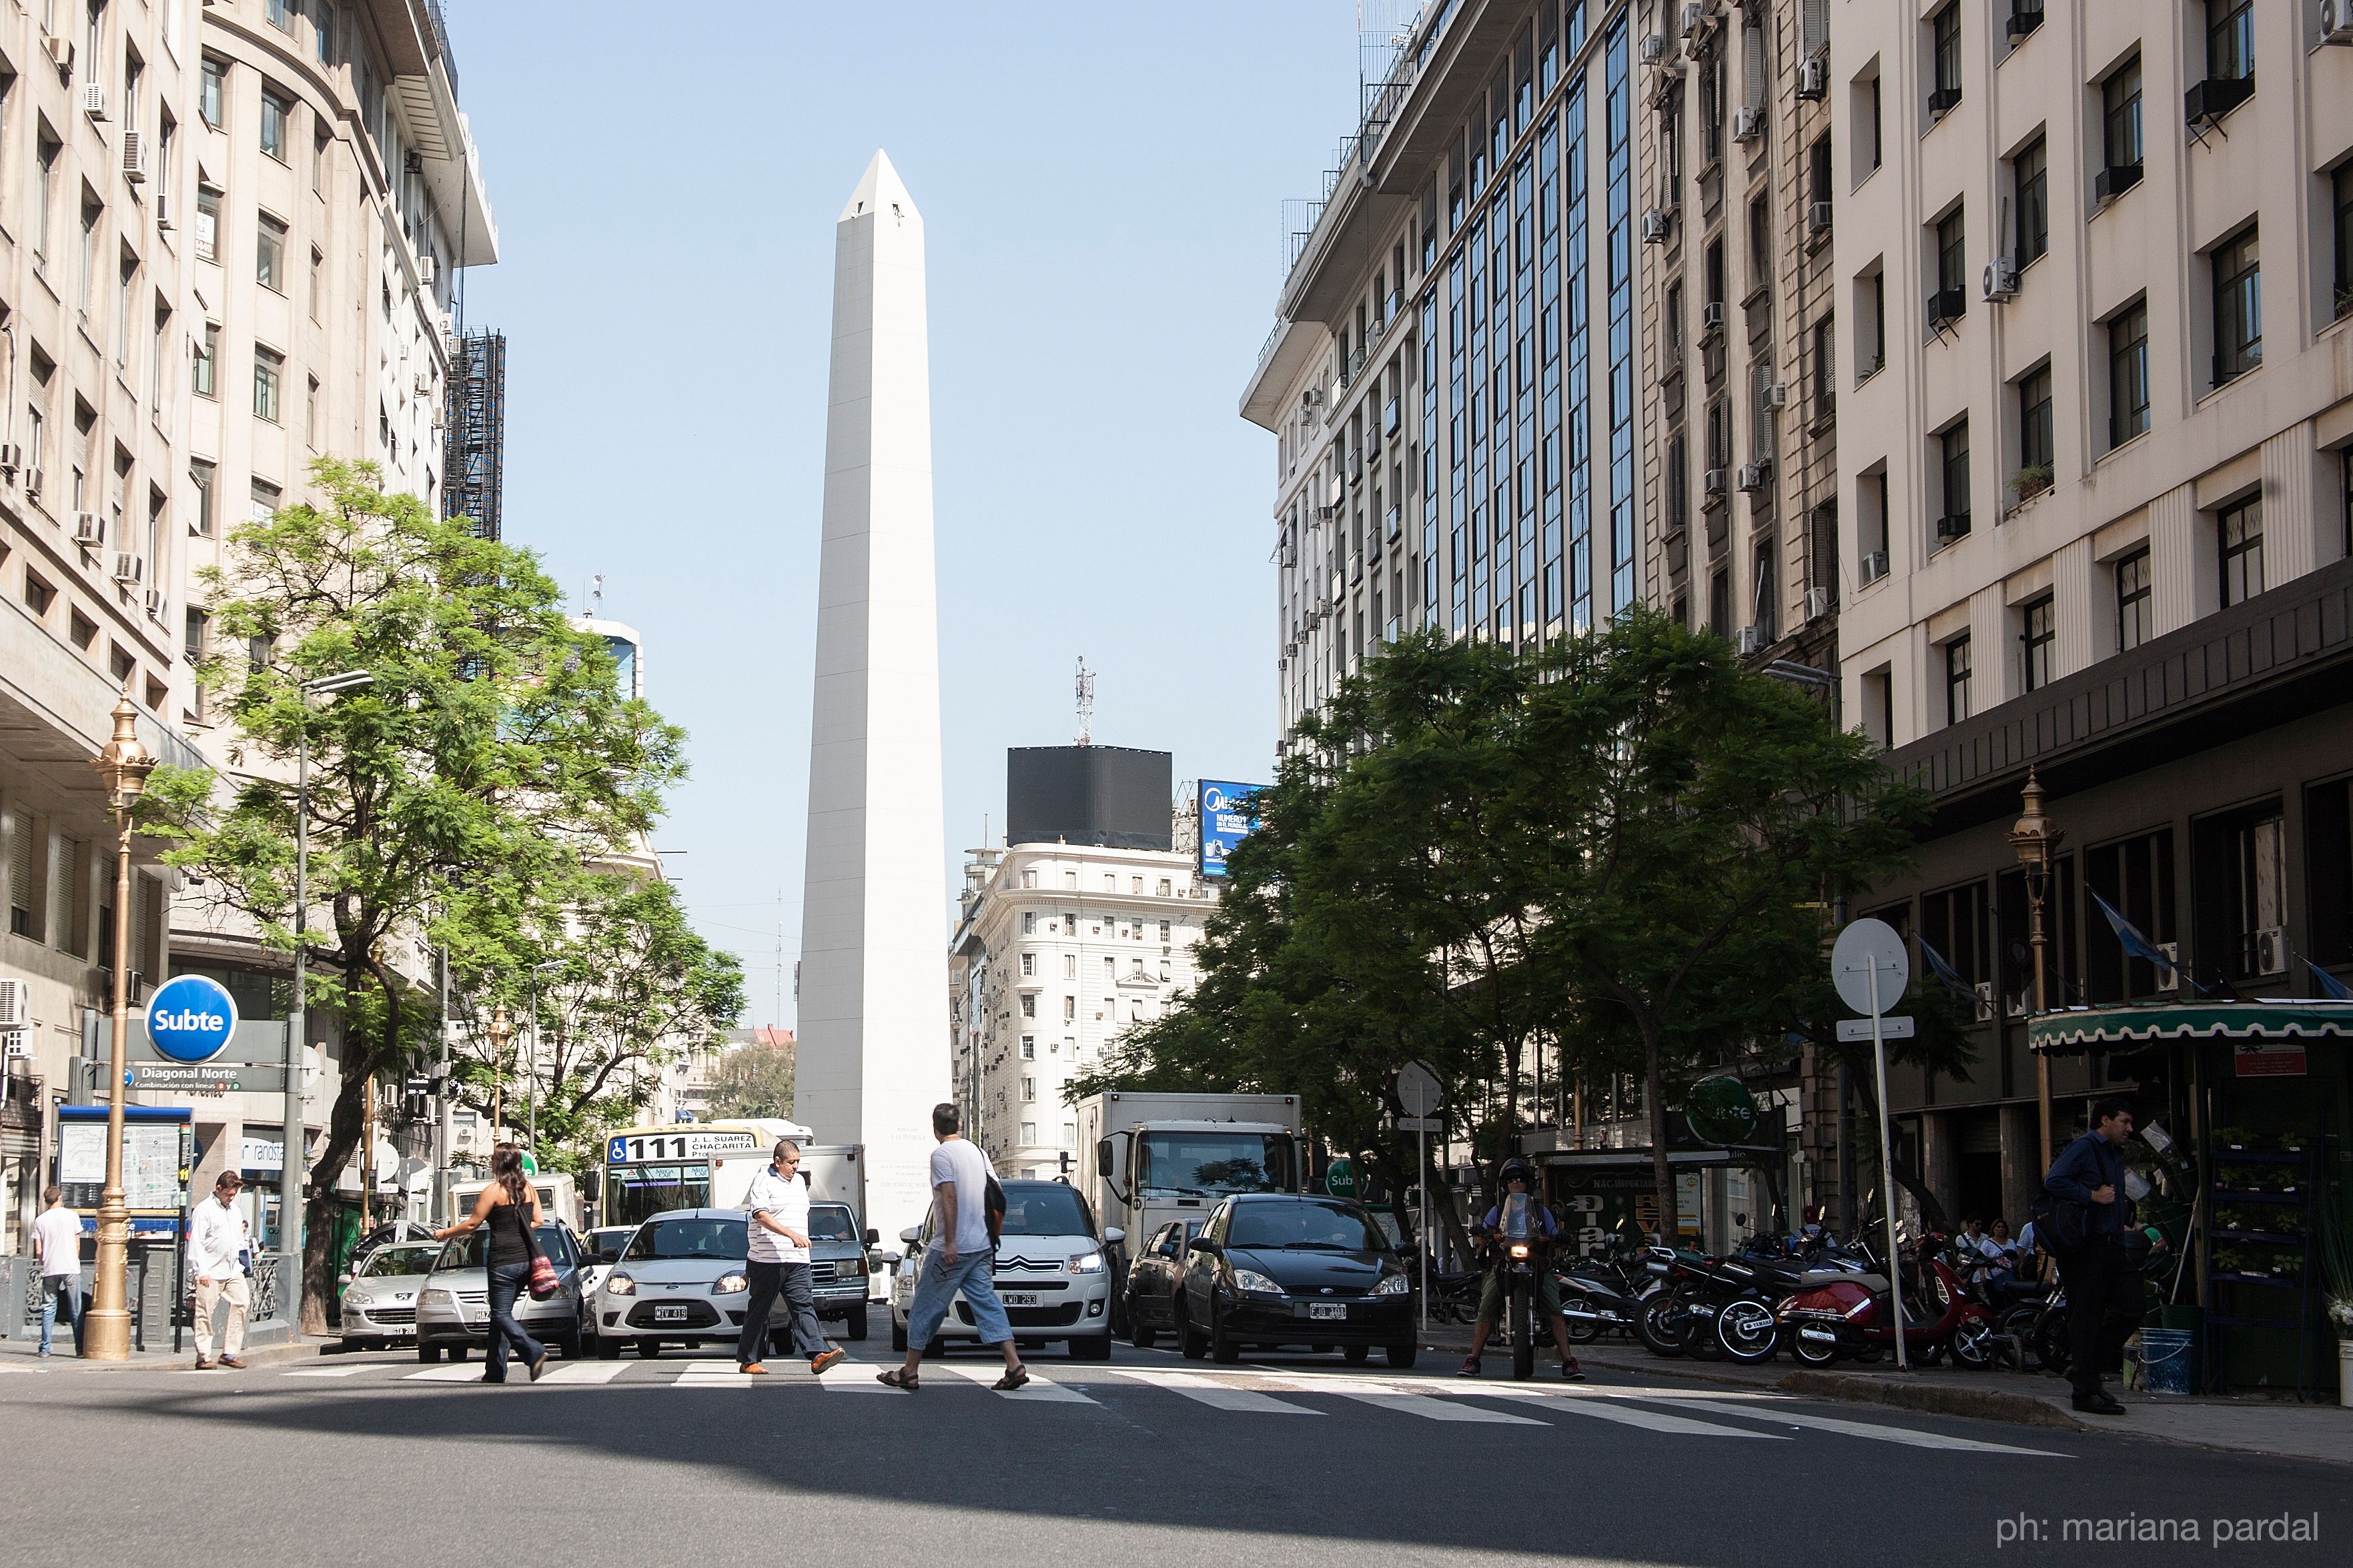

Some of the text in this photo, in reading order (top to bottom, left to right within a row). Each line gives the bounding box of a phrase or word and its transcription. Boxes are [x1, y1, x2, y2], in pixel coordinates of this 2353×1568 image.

[155, 1008, 224, 1031] Subte
[141, 1067, 238, 1081] Diagonal Norte
[135, 1081, 180, 1089] Combinación
[254, 1144, 284, 1160] randsta
[628, 1137, 686, 1159] 111
[1728, 1150, 1746, 1158] ulio
[1332, 1174, 1364, 1186] Sub
[1003, 1295, 1036, 1304] LWD 293
[476, 1311, 490, 1320] HAZ
[656, 1309, 686, 1317] MIV 419
[1312, 1307, 1326, 1316] FJQ
[1752, 1318, 1773, 1329] YAMAHA
